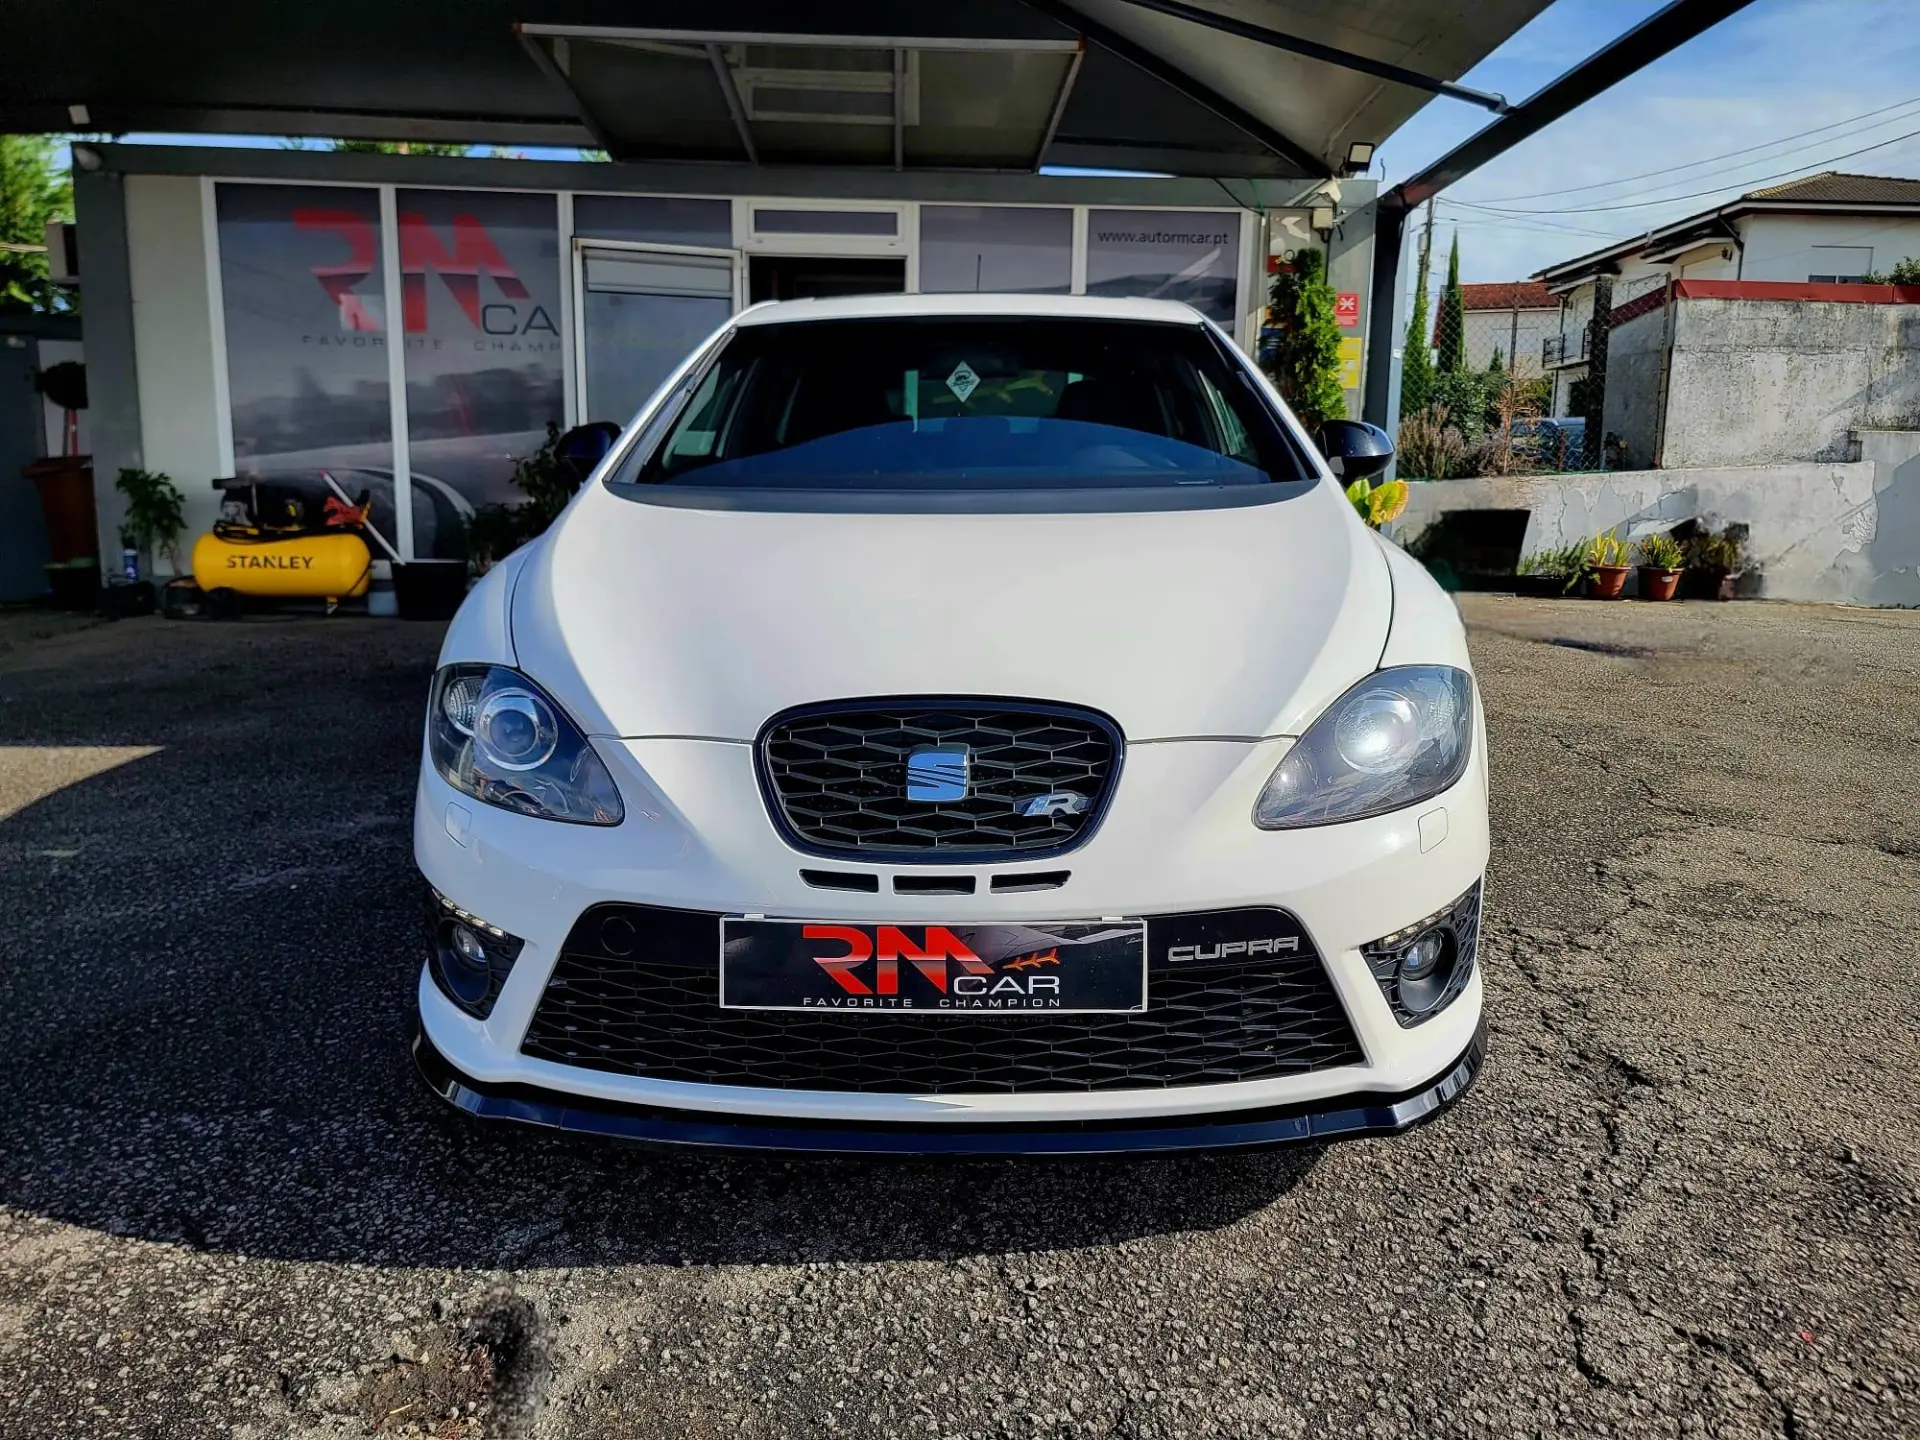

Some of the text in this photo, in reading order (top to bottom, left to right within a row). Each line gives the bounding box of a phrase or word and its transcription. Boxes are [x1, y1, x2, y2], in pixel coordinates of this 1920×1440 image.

[1098, 231, 1229, 246] www.autormcar.pt
[481, 304, 560, 336] CA
[227, 555, 313, 569] STANLEY
[1167, 937, 1299, 962] CUPRA
[953, 975, 1060, 996] CAR
[802, 997, 1060, 1008] FAVORITE CHAMPION
